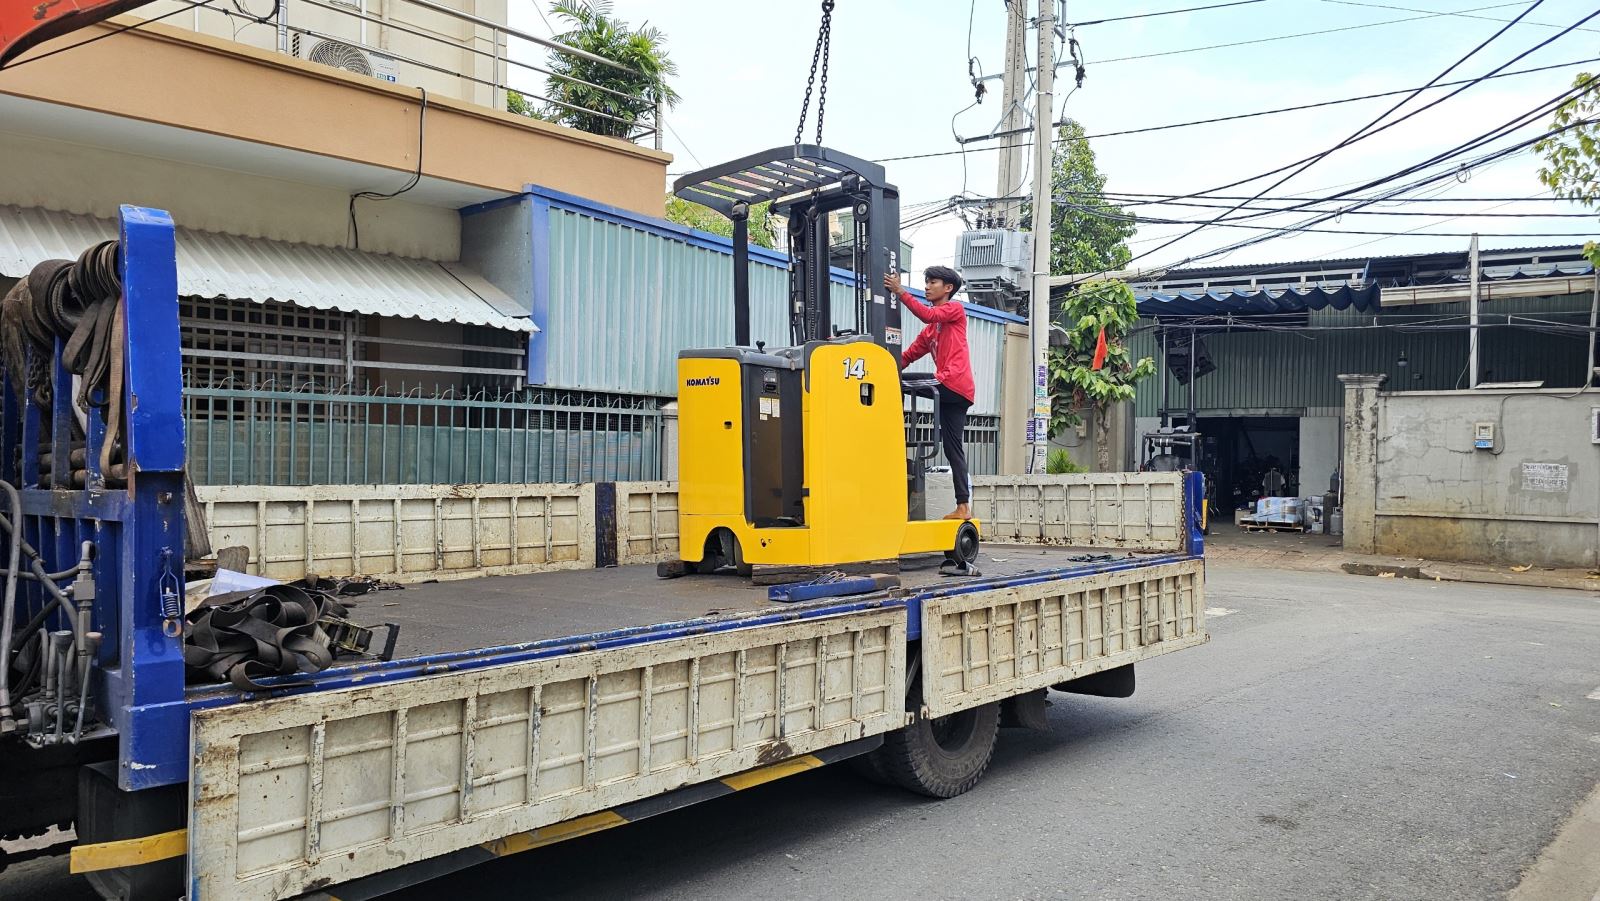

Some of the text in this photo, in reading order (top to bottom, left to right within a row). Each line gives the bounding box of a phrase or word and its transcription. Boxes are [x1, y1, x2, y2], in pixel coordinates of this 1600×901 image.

[889, 251, 897, 309] KOTSU
[843, 357, 865, 380] 14
[686, 376, 720, 386] KOMATSU
